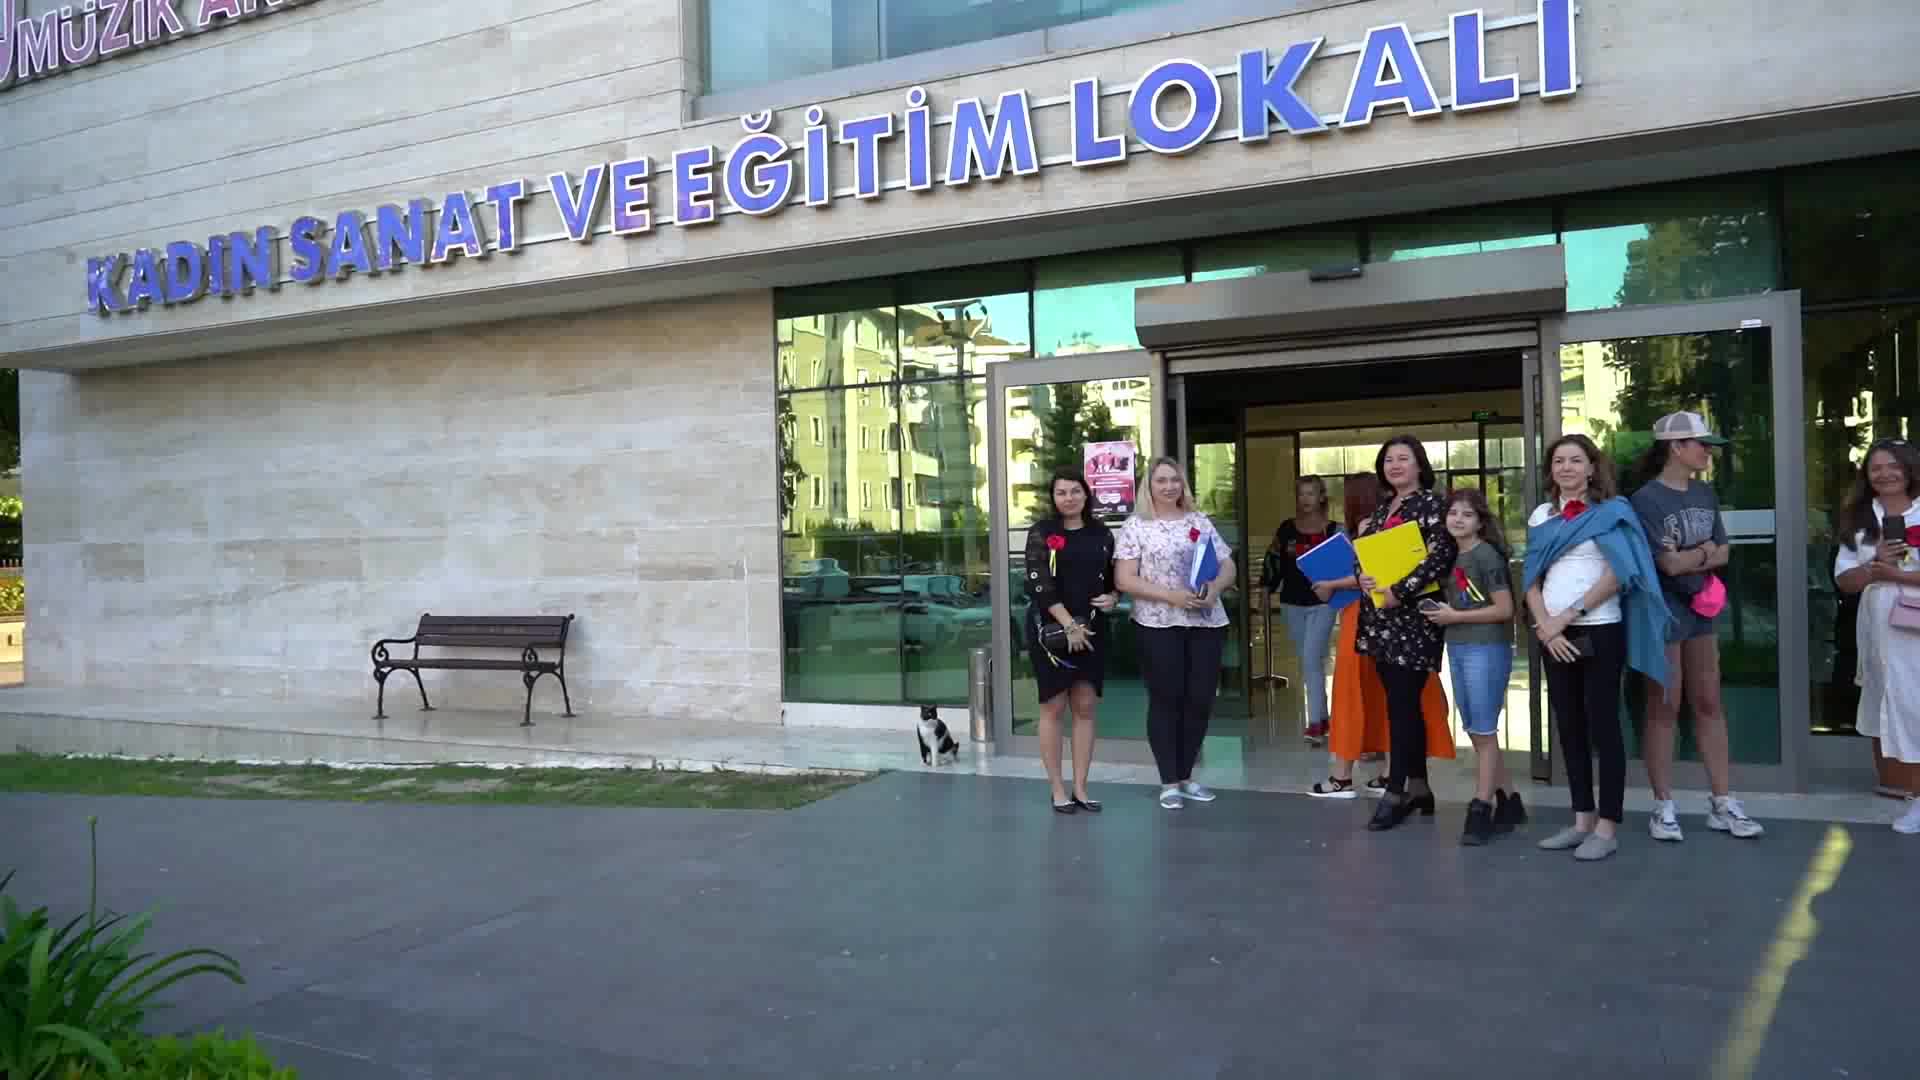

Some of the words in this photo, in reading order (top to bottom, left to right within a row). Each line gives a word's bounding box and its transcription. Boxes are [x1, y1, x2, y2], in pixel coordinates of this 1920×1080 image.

[87, 225, 278, 312] KADIN
[289, 179, 524, 283] SANAT
[548, 157, 652, 241] VE
[671, 85, 1038, 227] EĞİTİM
